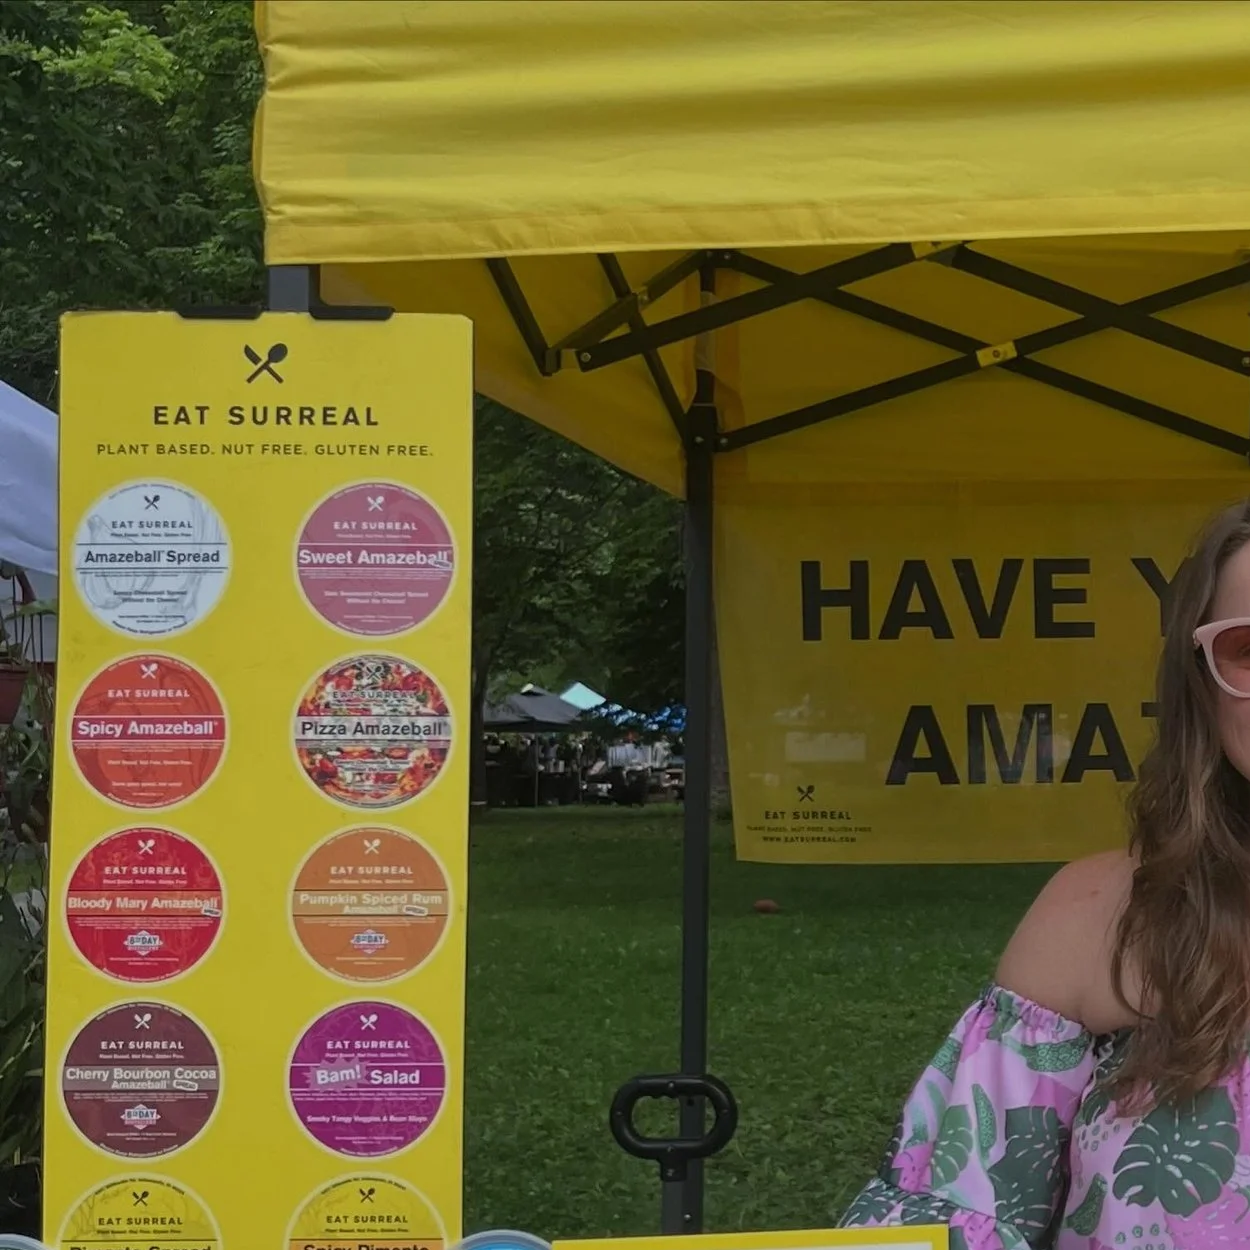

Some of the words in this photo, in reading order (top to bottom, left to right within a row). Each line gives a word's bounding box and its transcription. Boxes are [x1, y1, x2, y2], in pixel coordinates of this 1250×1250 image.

[153, 405, 210, 426] EAT
[228, 405, 380, 427] SURREAL
[96, 443, 150, 456] PLANT
[156, 443, 215, 456] BASED.
[222, 444, 255, 456] NUT
[261, 444, 308, 456] FREE.
[314, 444, 380, 457] GLUTEN
[386, 444, 434, 457] FREE.
[111, 520, 134, 529] EAT
[138, 520, 193, 529] SURREAL
[333, 521, 357, 530] EAT
[361, 521, 418, 531] SURREAL
[84, 549, 163, 563] Amazeball
[166, 549, 220, 565] Spread
[299, 549, 353, 564] Sweet
[801, 558, 1096, 641] HAVE
[107, 689, 131, 698] EAT
[134, 689, 190, 698] SURREAL
[77, 720, 123, 737] Spicy
[127, 720, 214, 735] Amazeball
[300, 721, 347, 736] Pizza
[352, 721, 443, 736] Amazeball
[764, 811, 786, 820] EAT
[792, 810, 852, 820] SURREAL
[104, 866, 128, 875] EAT
[132, 866, 187, 875] SURREAL
[67, 897, 113, 911] Bloody
[116, 897, 148, 911] Mary
[100, 1041, 124, 1050] EAT
[128, 1041, 185, 1050] SURREAL
[66, 1067, 110, 1082] Cherry
[113, 1067, 171, 1079] Bourbon
[174, 1067, 217, 1080] Cocoa
[316, 1064, 362, 1085] Bam!
[370, 1069, 420, 1085] Salad
